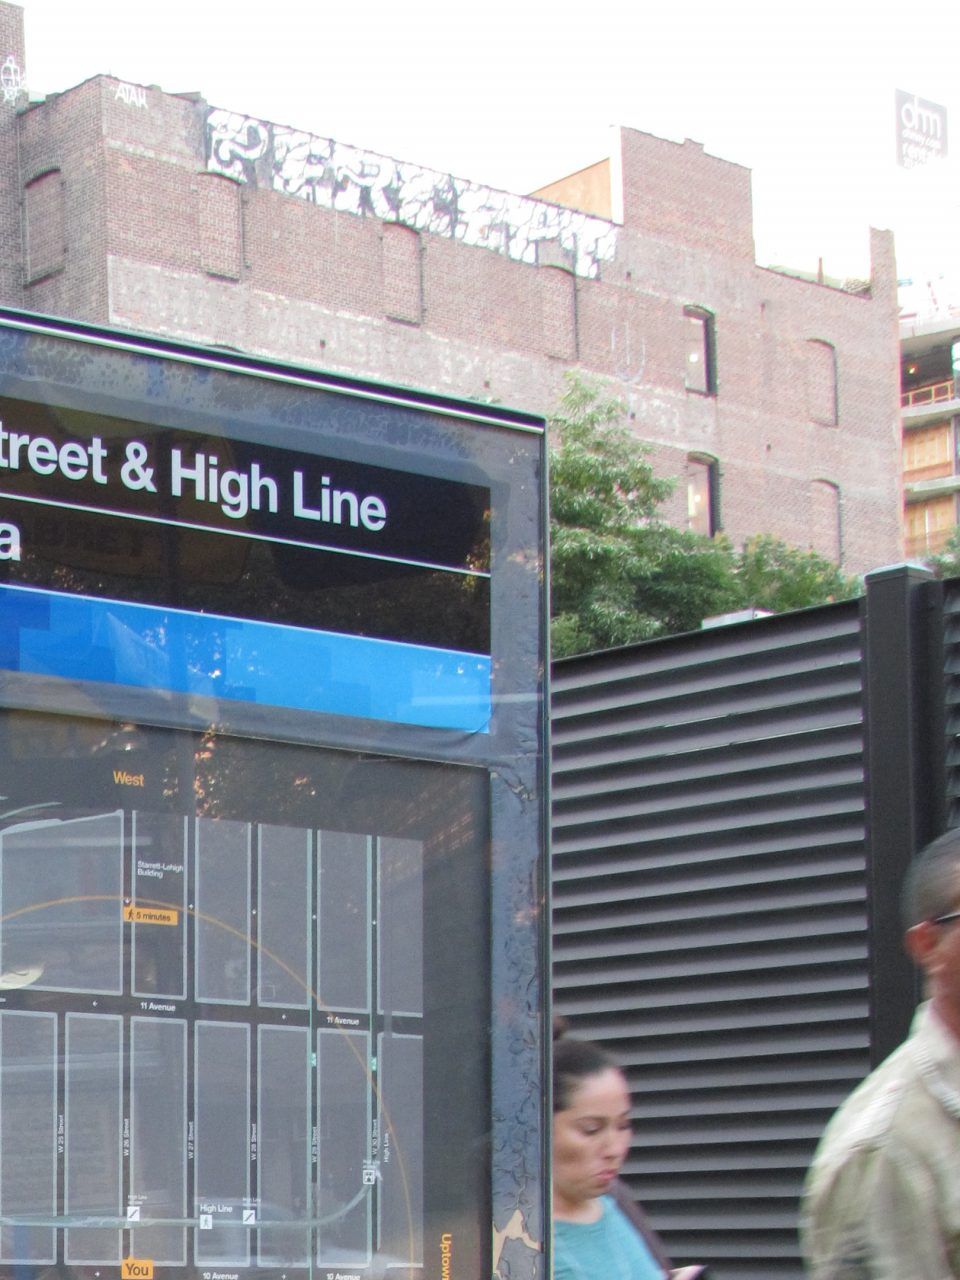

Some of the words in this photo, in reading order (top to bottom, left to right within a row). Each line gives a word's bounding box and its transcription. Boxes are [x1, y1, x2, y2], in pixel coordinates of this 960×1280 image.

[121, 440, 157, 492] &
[171, 447, 278, 521] High
[293, 471, 387, 532] Line
[113, 770, 145, 788] West
[137, 860, 184, 875] Starrett-Lehigh
[137, 868, 164, 880] Building
[142, 912, 171, 922] minutes
[140, 1001, 148, 1010] 11
[148, 1002, 176, 1013] Avenue
[326, 1016, 333, 1025] 11
[334, 1017, 360, 1026] Avenue
[200, 1203, 216, 1214] High
[217, 1204, 233, 1213] Line
[125, 1263, 149, 1277] You
[203, 1272, 211, 1280] 10
[326, 1273, 334, 1280] 10
